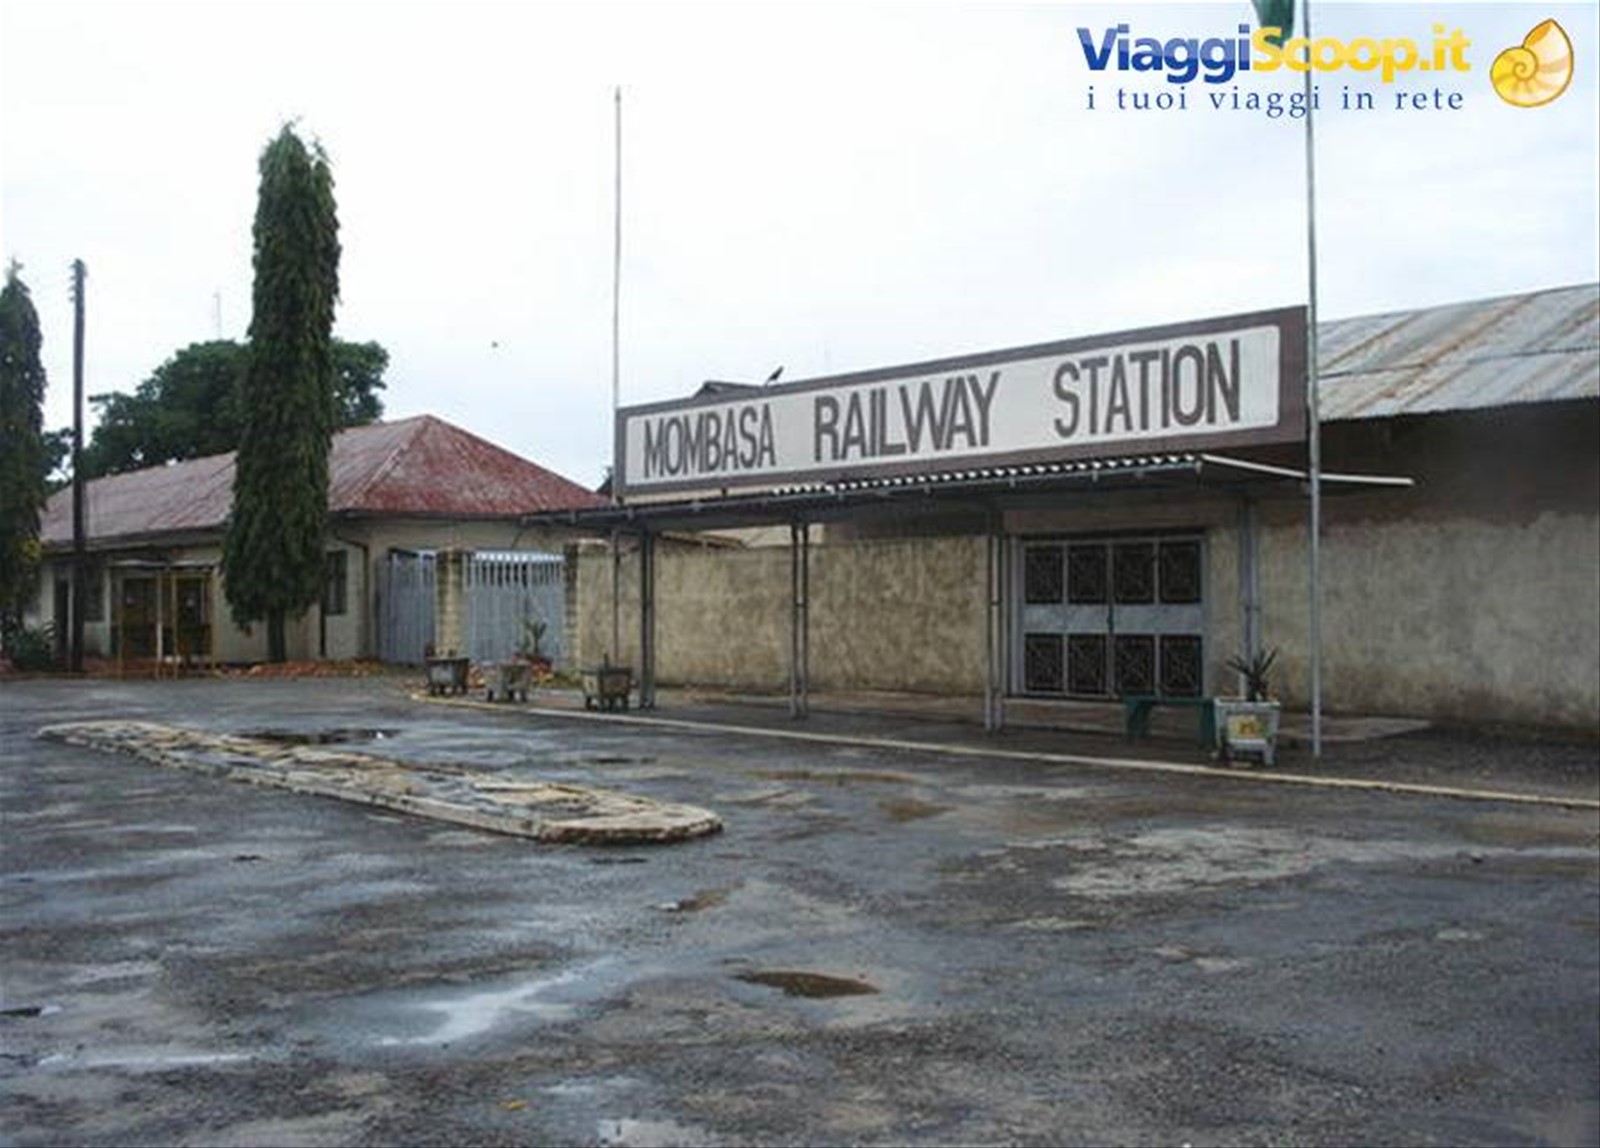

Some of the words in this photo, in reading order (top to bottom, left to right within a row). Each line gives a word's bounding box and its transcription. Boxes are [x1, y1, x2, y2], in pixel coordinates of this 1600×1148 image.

[643, 403, 776, 479] MOMBASA
[814, 371, 1000, 463] RAILWAY
[1053, 339, 1240, 439] STATION
